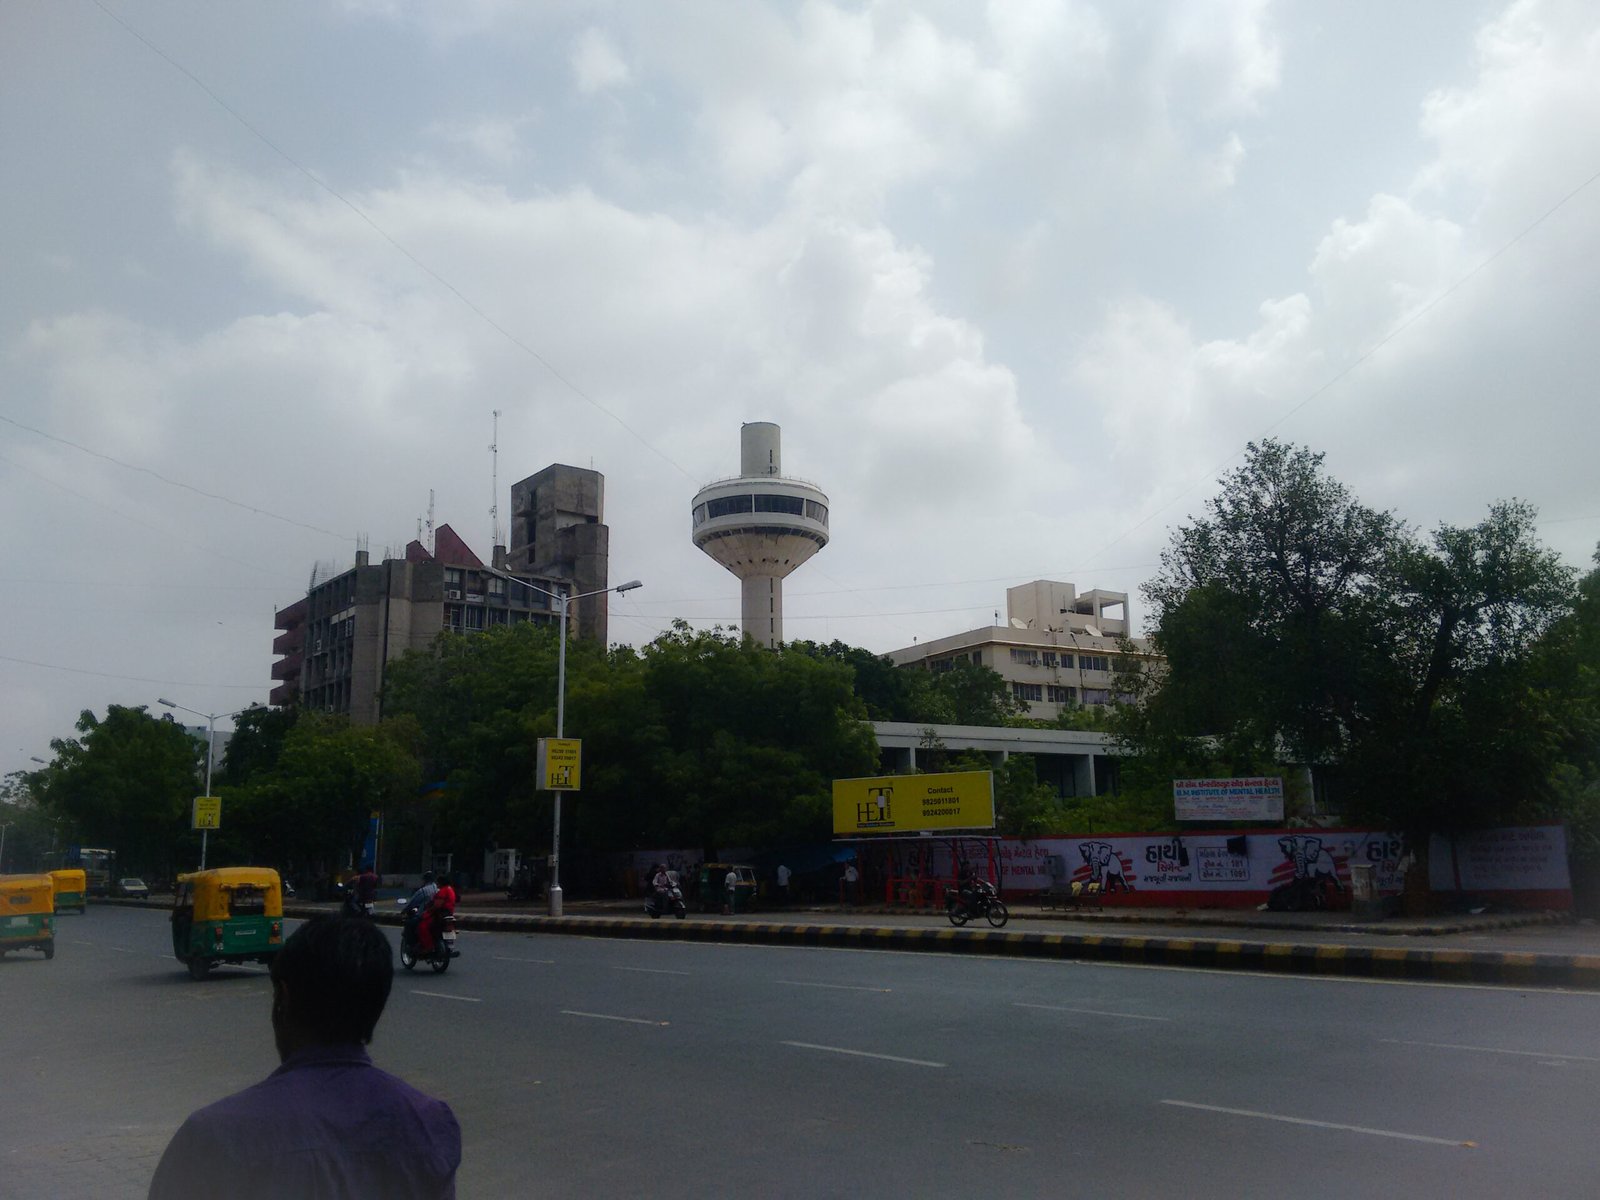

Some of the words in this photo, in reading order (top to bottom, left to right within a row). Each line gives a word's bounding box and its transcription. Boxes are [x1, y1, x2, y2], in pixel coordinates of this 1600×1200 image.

[927, 786, 954, 794] Contact
[1191, 788, 1219, 796] INSTITUTE
[1255, 787, 1280, 795] HEALTH
[1011, 864, 1035, 876] MENTAL
